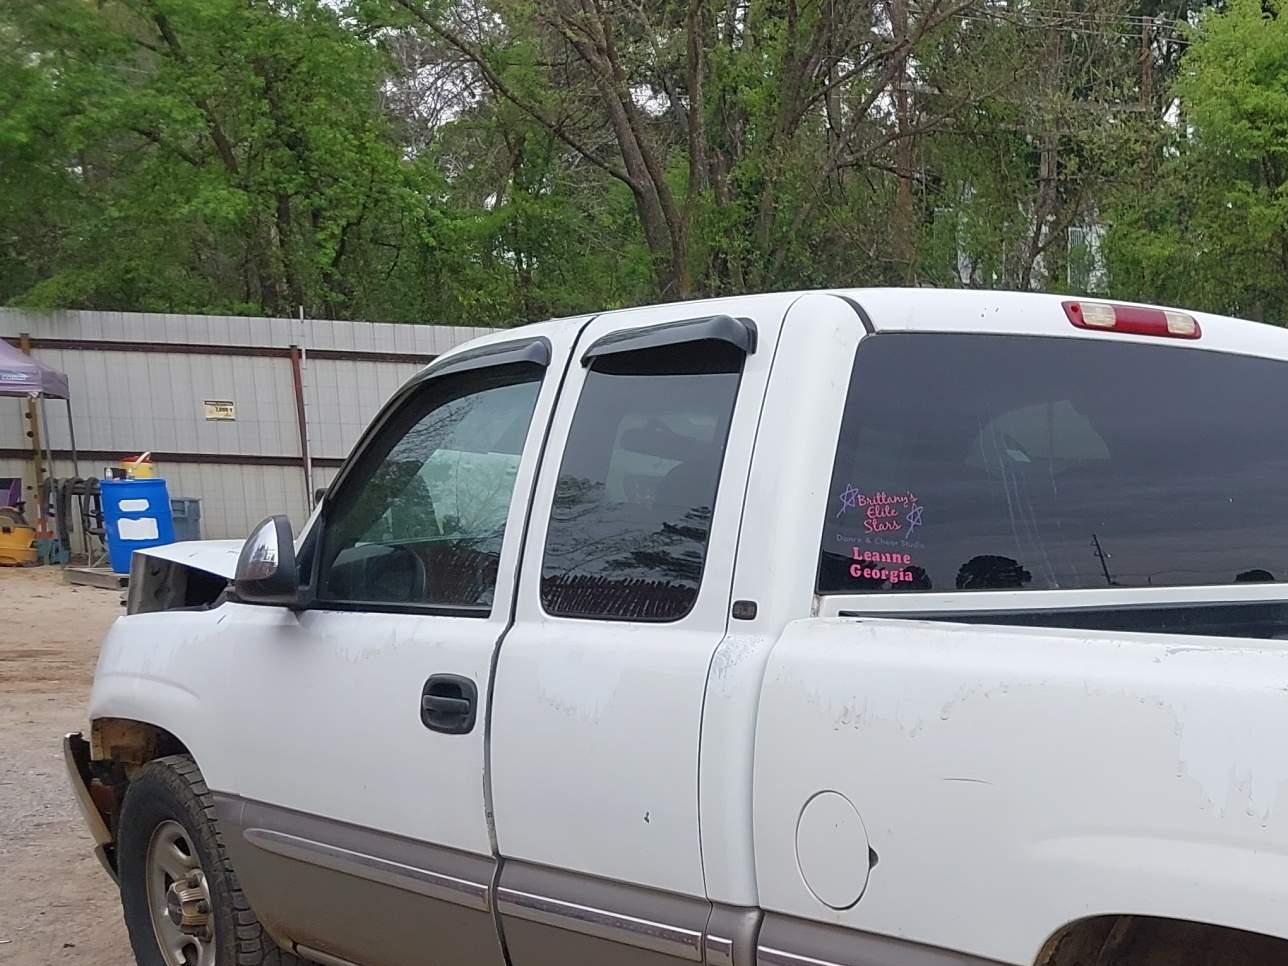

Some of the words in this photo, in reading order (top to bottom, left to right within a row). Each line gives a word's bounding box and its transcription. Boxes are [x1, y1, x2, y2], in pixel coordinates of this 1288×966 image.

[866, 506, 898, 519] Elite
[863, 519, 902, 534] Stars
[852, 547, 911, 564] Leanne
[849, 564, 914, 584] Georgia
